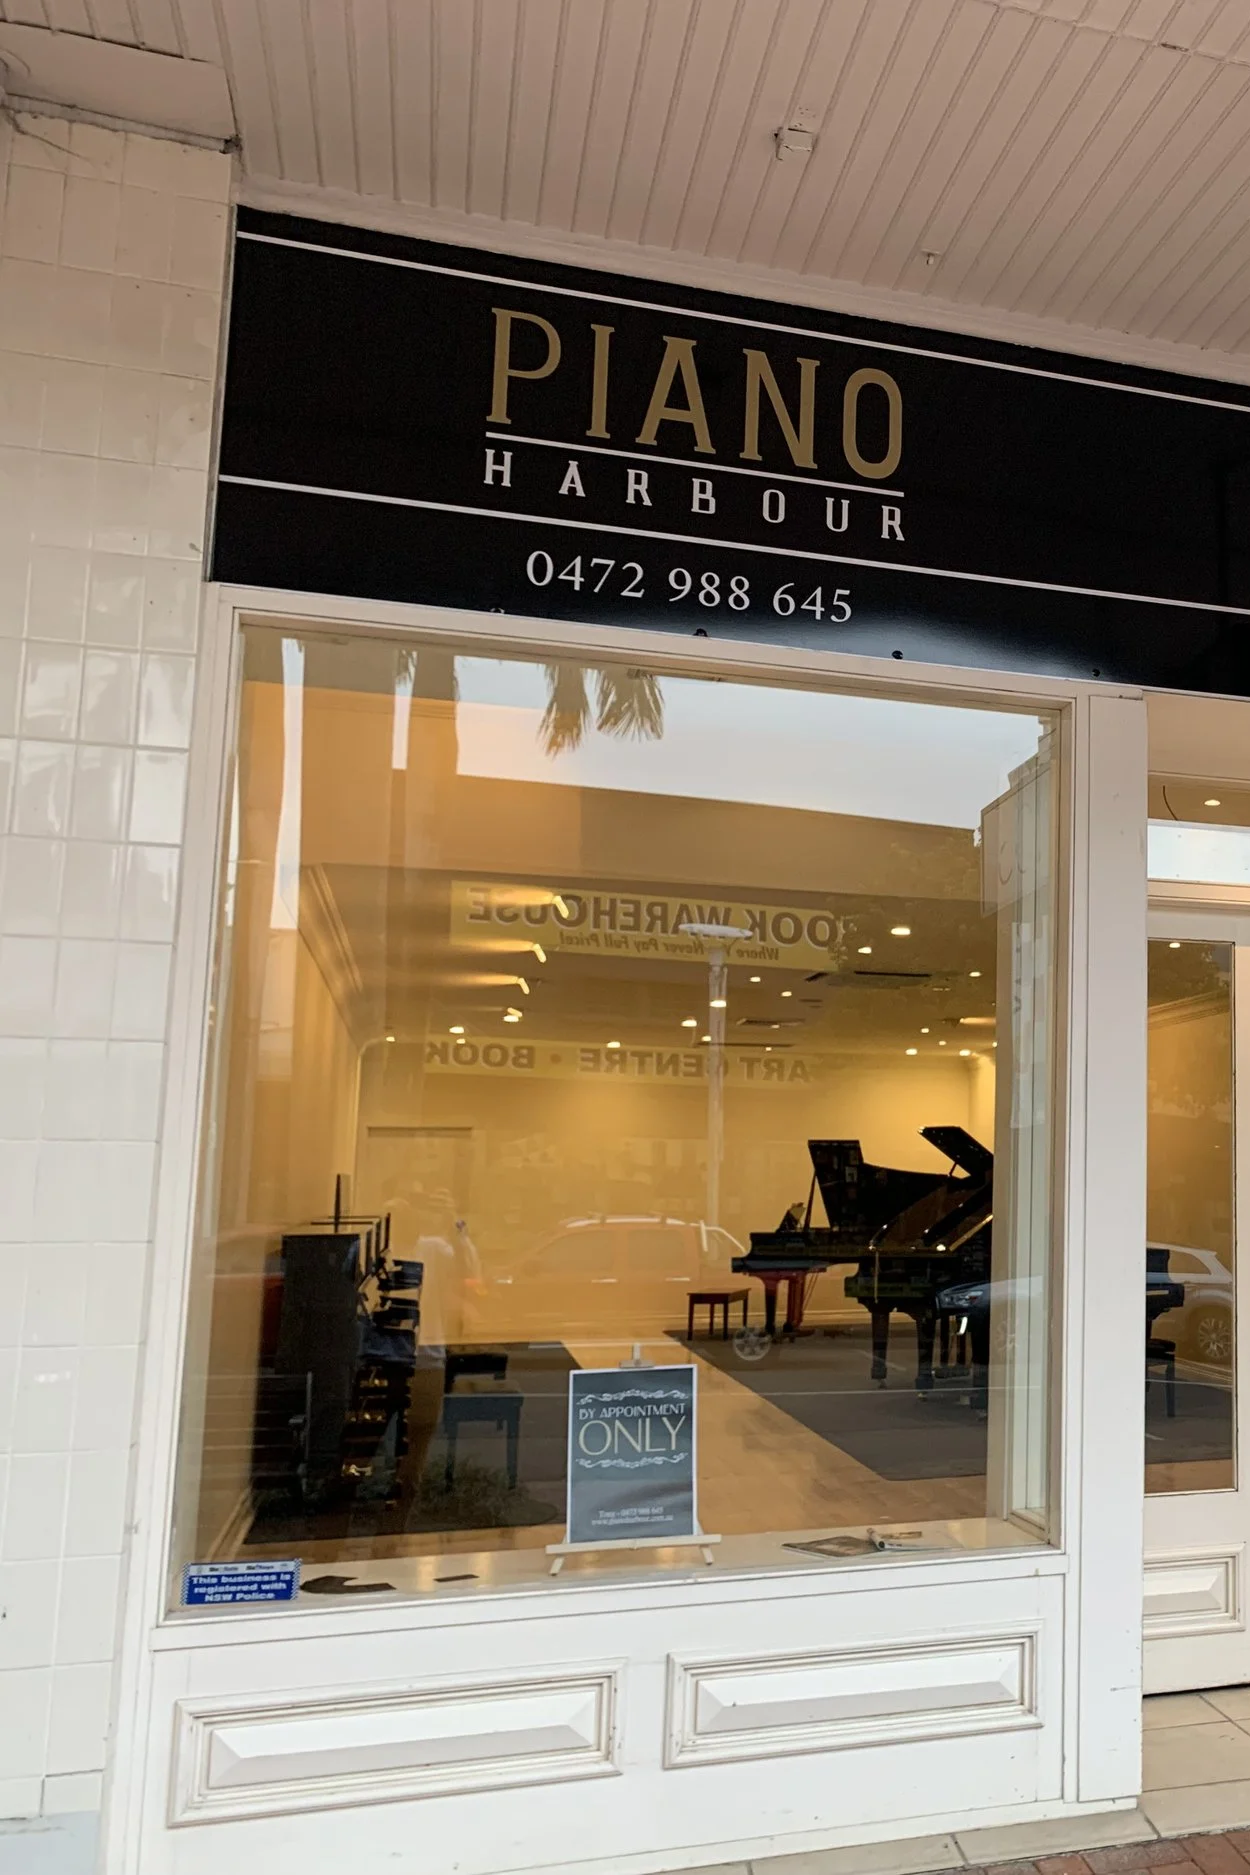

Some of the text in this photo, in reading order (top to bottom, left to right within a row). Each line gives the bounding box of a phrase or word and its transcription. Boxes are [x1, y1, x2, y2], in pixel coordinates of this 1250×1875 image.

[486, 307, 903, 480] PIANO
[483, 448, 906, 542] HARBOUR
[526, 550, 853, 624] 0472 988 645
[579, 1403, 686, 1420] BY APPOINTMENT
[578, 1415, 686, 1456] ONLY
[194, 1582, 287, 1595] registered with
[221, 1574, 278, 1584] business
[280, 1572, 291, 1581] is
[204, 1592, 276, 1603] NSW Police
